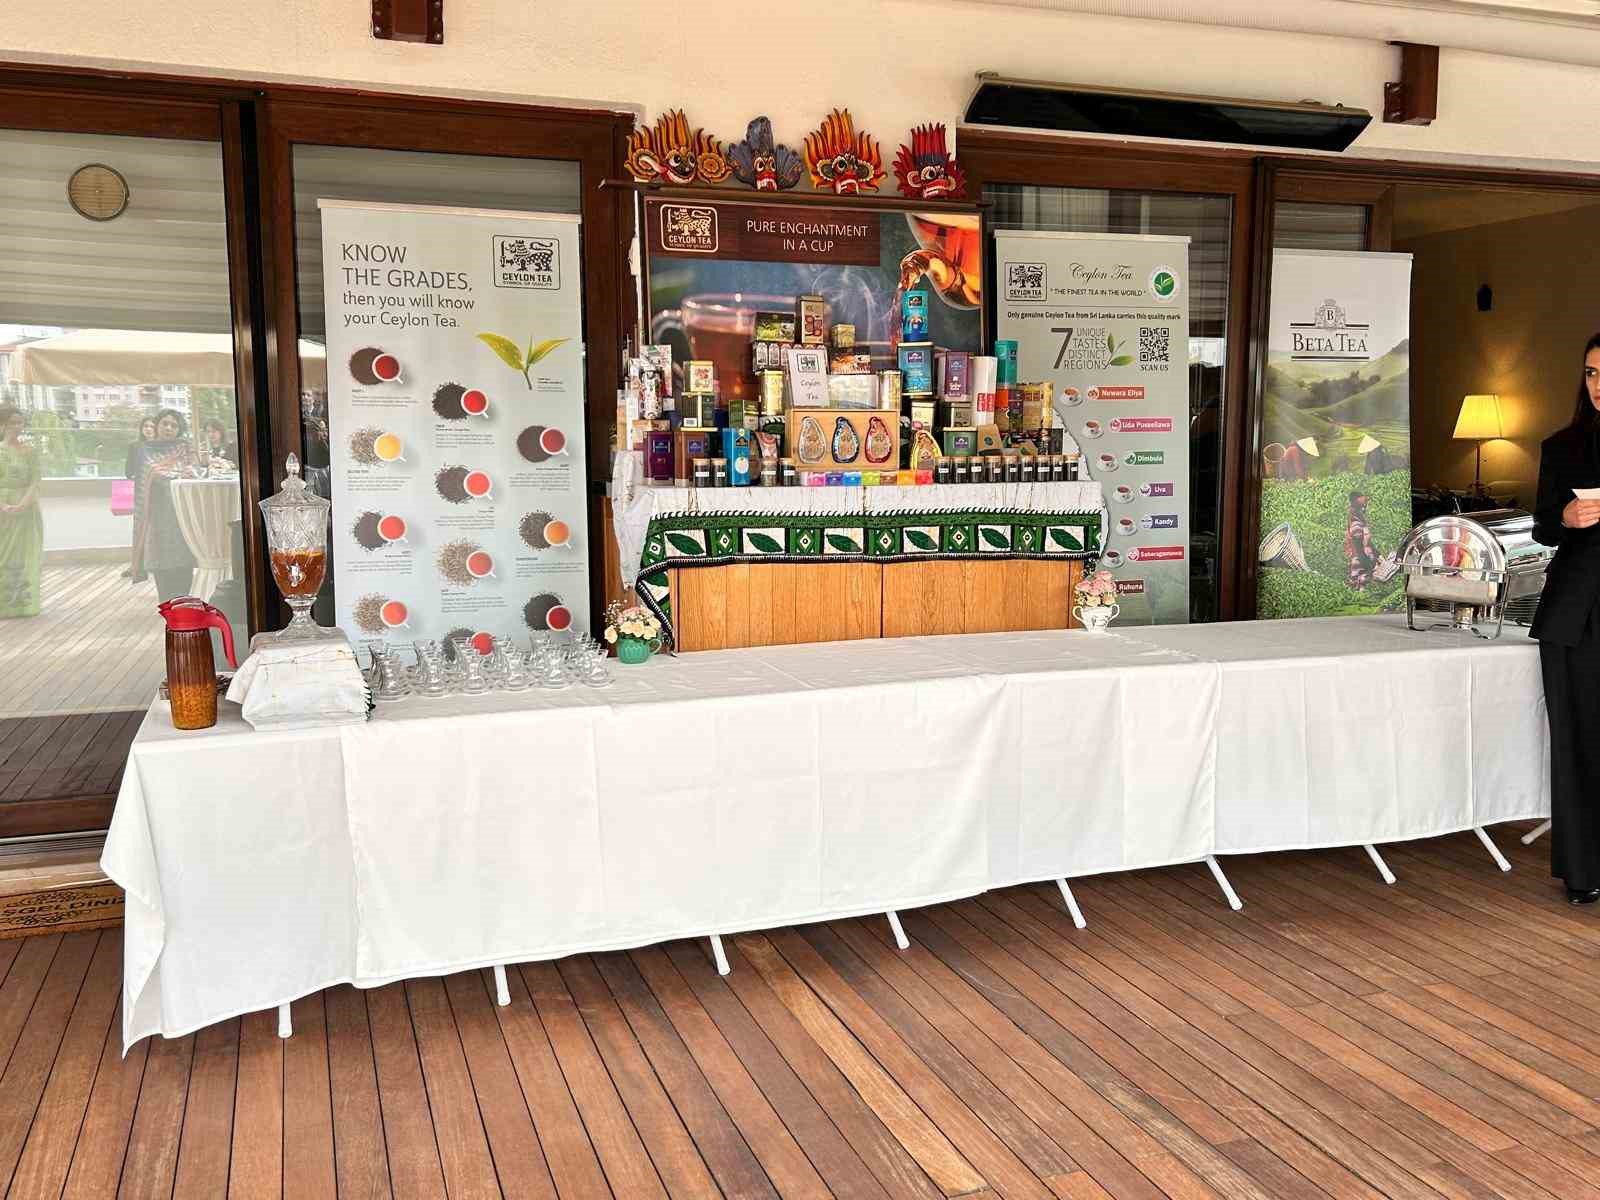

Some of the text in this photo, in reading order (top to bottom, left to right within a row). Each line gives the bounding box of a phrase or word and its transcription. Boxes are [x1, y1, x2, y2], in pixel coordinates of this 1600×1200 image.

[747, 220, 868, 237] PURE ENCHANTMENT
[669, 235, 712, 244] CEYLON TEA
[783, 239, 834, 252] IN A CUP
[341, 244, 407, 264] KNOW
[502, 272, 552, 282] CEYLON TEA
[1069, 262, 1135, 285] Ceylon Tea
[342, 267, 473, 292] THE GRADES,
[343, 291, 475, 310] then you will know
[344, 311, 461, 330] your Ceylon Tea.
[1008, 311, 1020, 320] Only
[1020, 312, 1044, 320] genuine
[1045, 312, 1064, 320] Ceylon
[1098, 312, 1116, 320] Lanka
[1148, 313, 1165, 321] quality
[1076, 328, 1106, 338] UNIQUE
[1050, 328, 1074, 370] 7
[1072, 338, 1106, 349] TASTES
[1068, 350, 1106, 360] DISTINCT
[1064, 360, 1107, 370] REGIONS
[1140, 364, 1168, 372] SCAN US
[1154, 518, 1174, 526] Kandy
